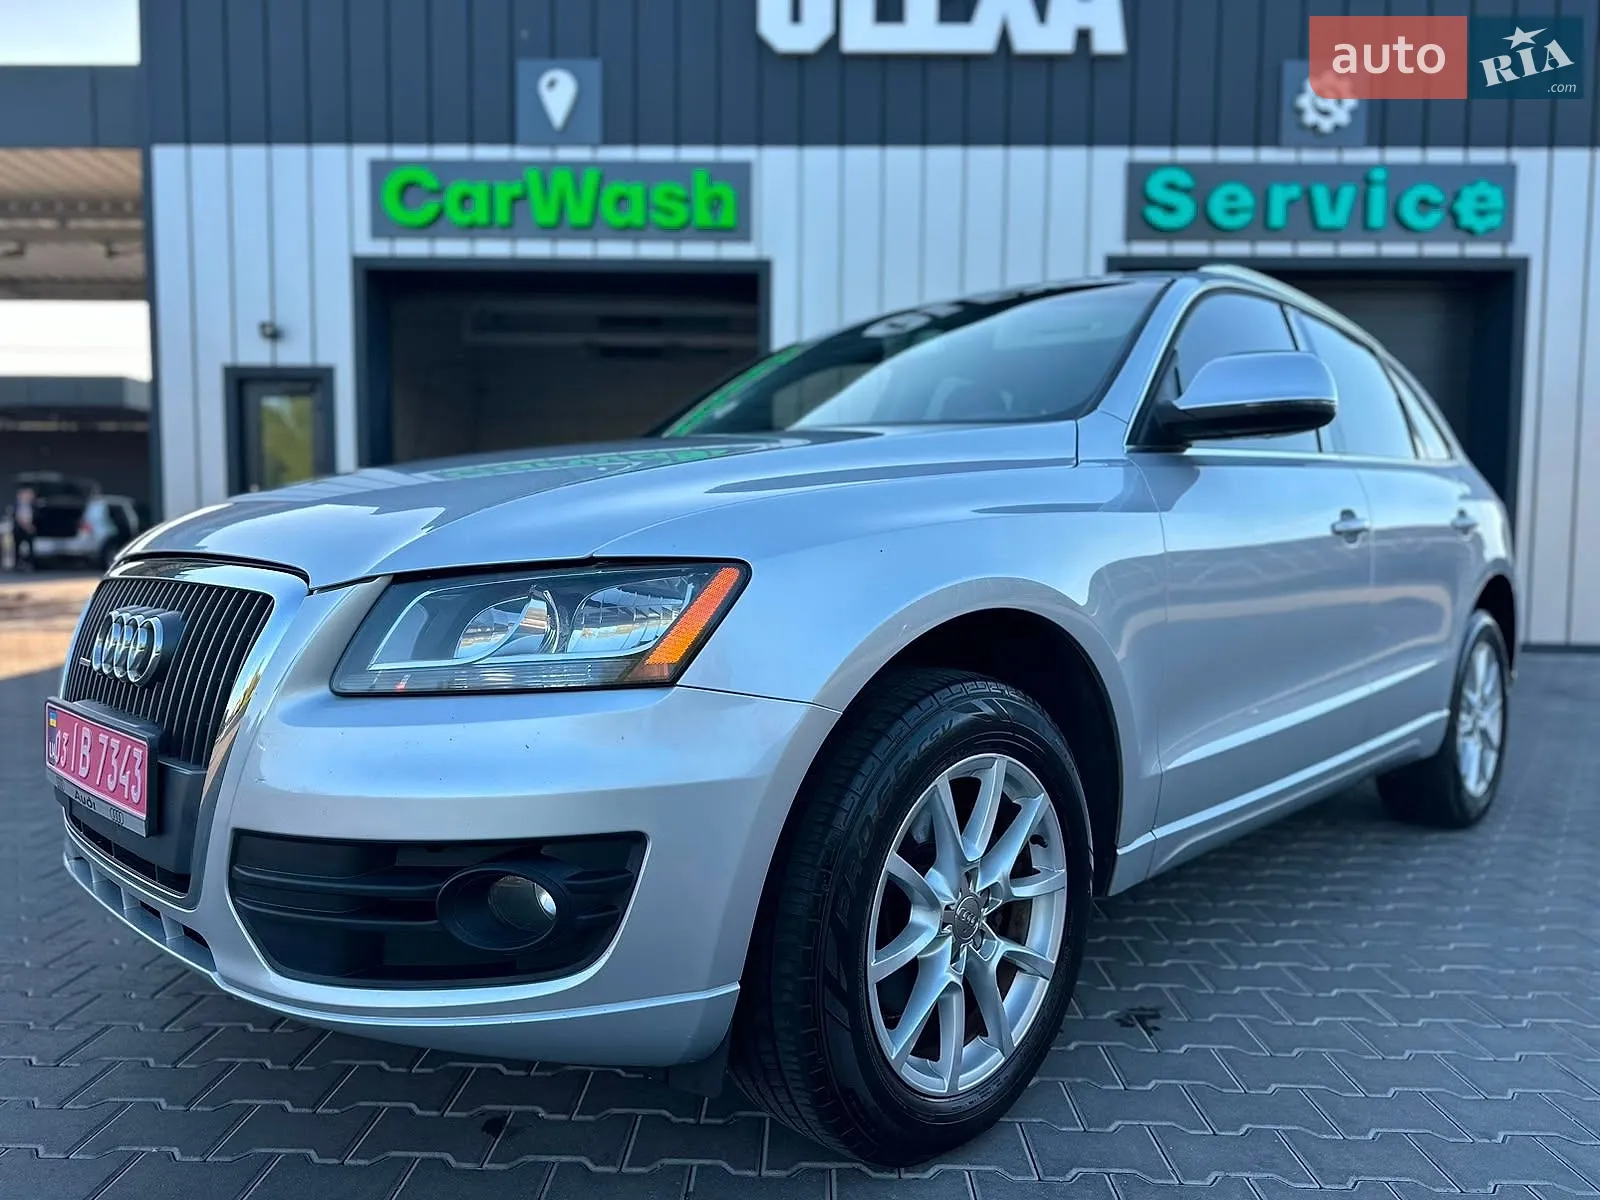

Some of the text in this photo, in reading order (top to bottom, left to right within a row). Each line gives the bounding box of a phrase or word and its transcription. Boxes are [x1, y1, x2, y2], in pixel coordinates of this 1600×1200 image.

[380, 164, 738, 230] CarWash
[1142, 165, 1506, 235] Service
[96, 733, 143, 804] 7343
